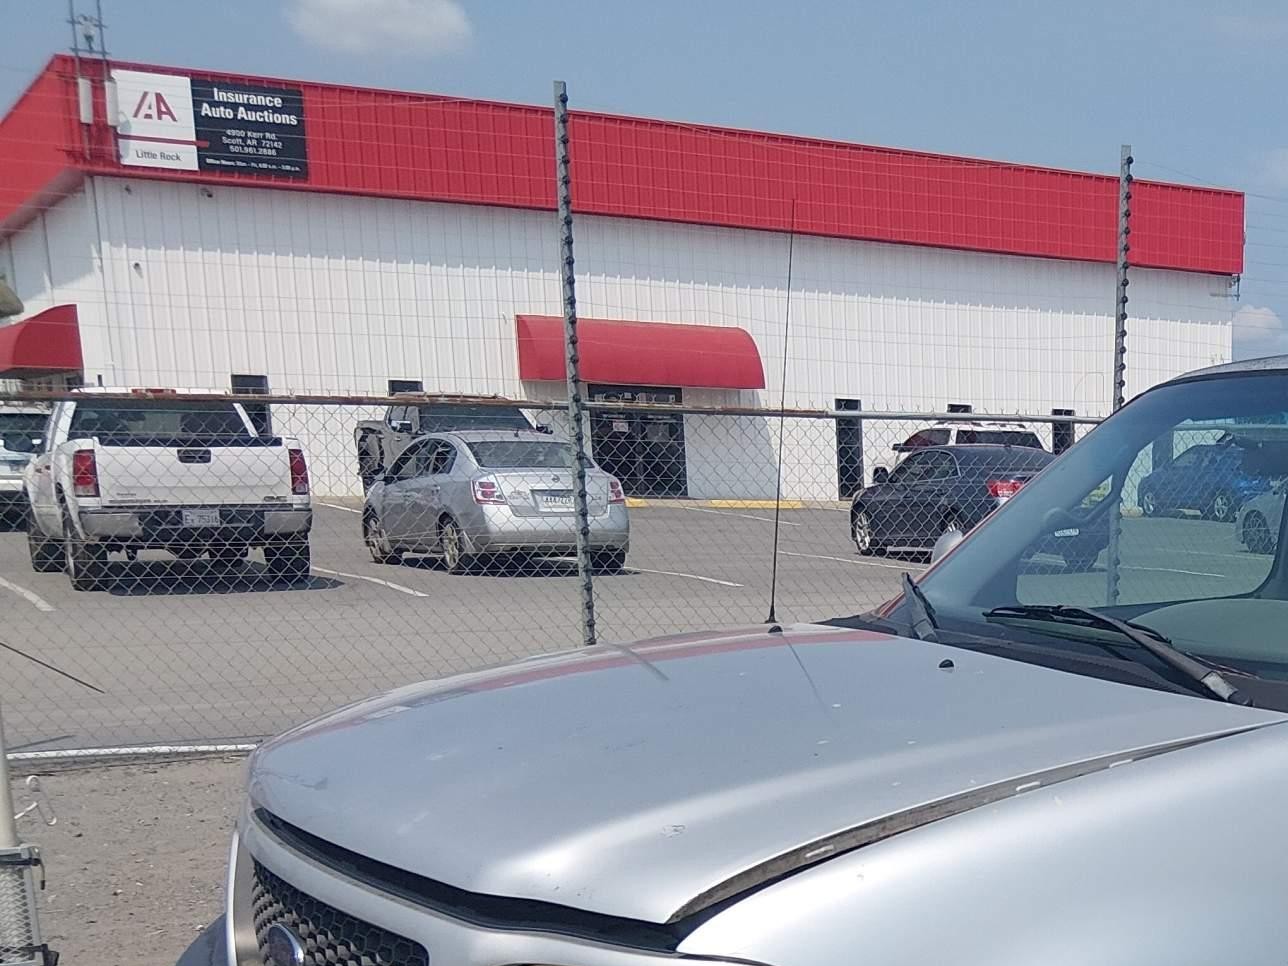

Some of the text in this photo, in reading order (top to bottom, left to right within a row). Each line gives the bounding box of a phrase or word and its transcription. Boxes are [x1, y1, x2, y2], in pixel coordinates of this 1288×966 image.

[213, 88, 282, 107] Insurance
[201, 103, 298, 126] Auto Auctions
[246, 138, 258, 147] AR
[261, 140, 283, 149] 72142
[136, 150, 183, 162] Little Rock
